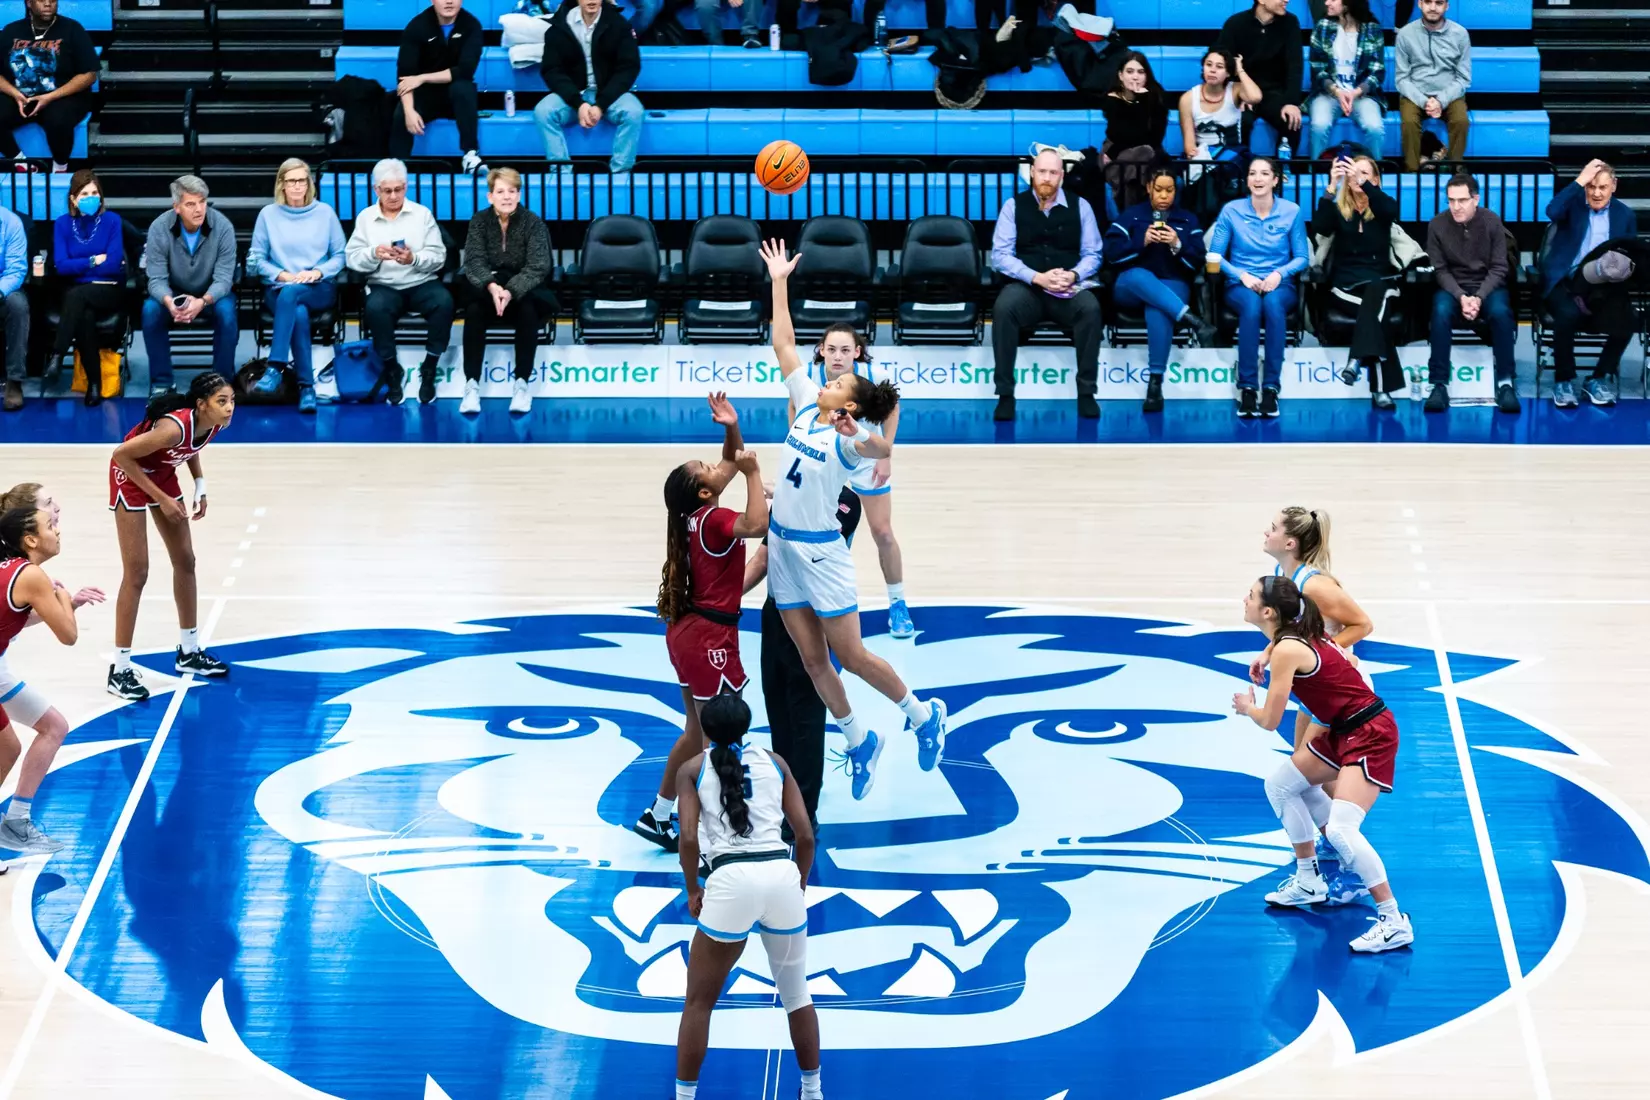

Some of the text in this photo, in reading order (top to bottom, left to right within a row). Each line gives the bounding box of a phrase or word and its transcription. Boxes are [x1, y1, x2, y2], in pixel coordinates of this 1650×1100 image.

[783, 159, 806, 183] ELITE
[484, 361, 659, 383] icketSmarter
[786, 457, 803, 489] 4
[712, 651, 724, 664] H
